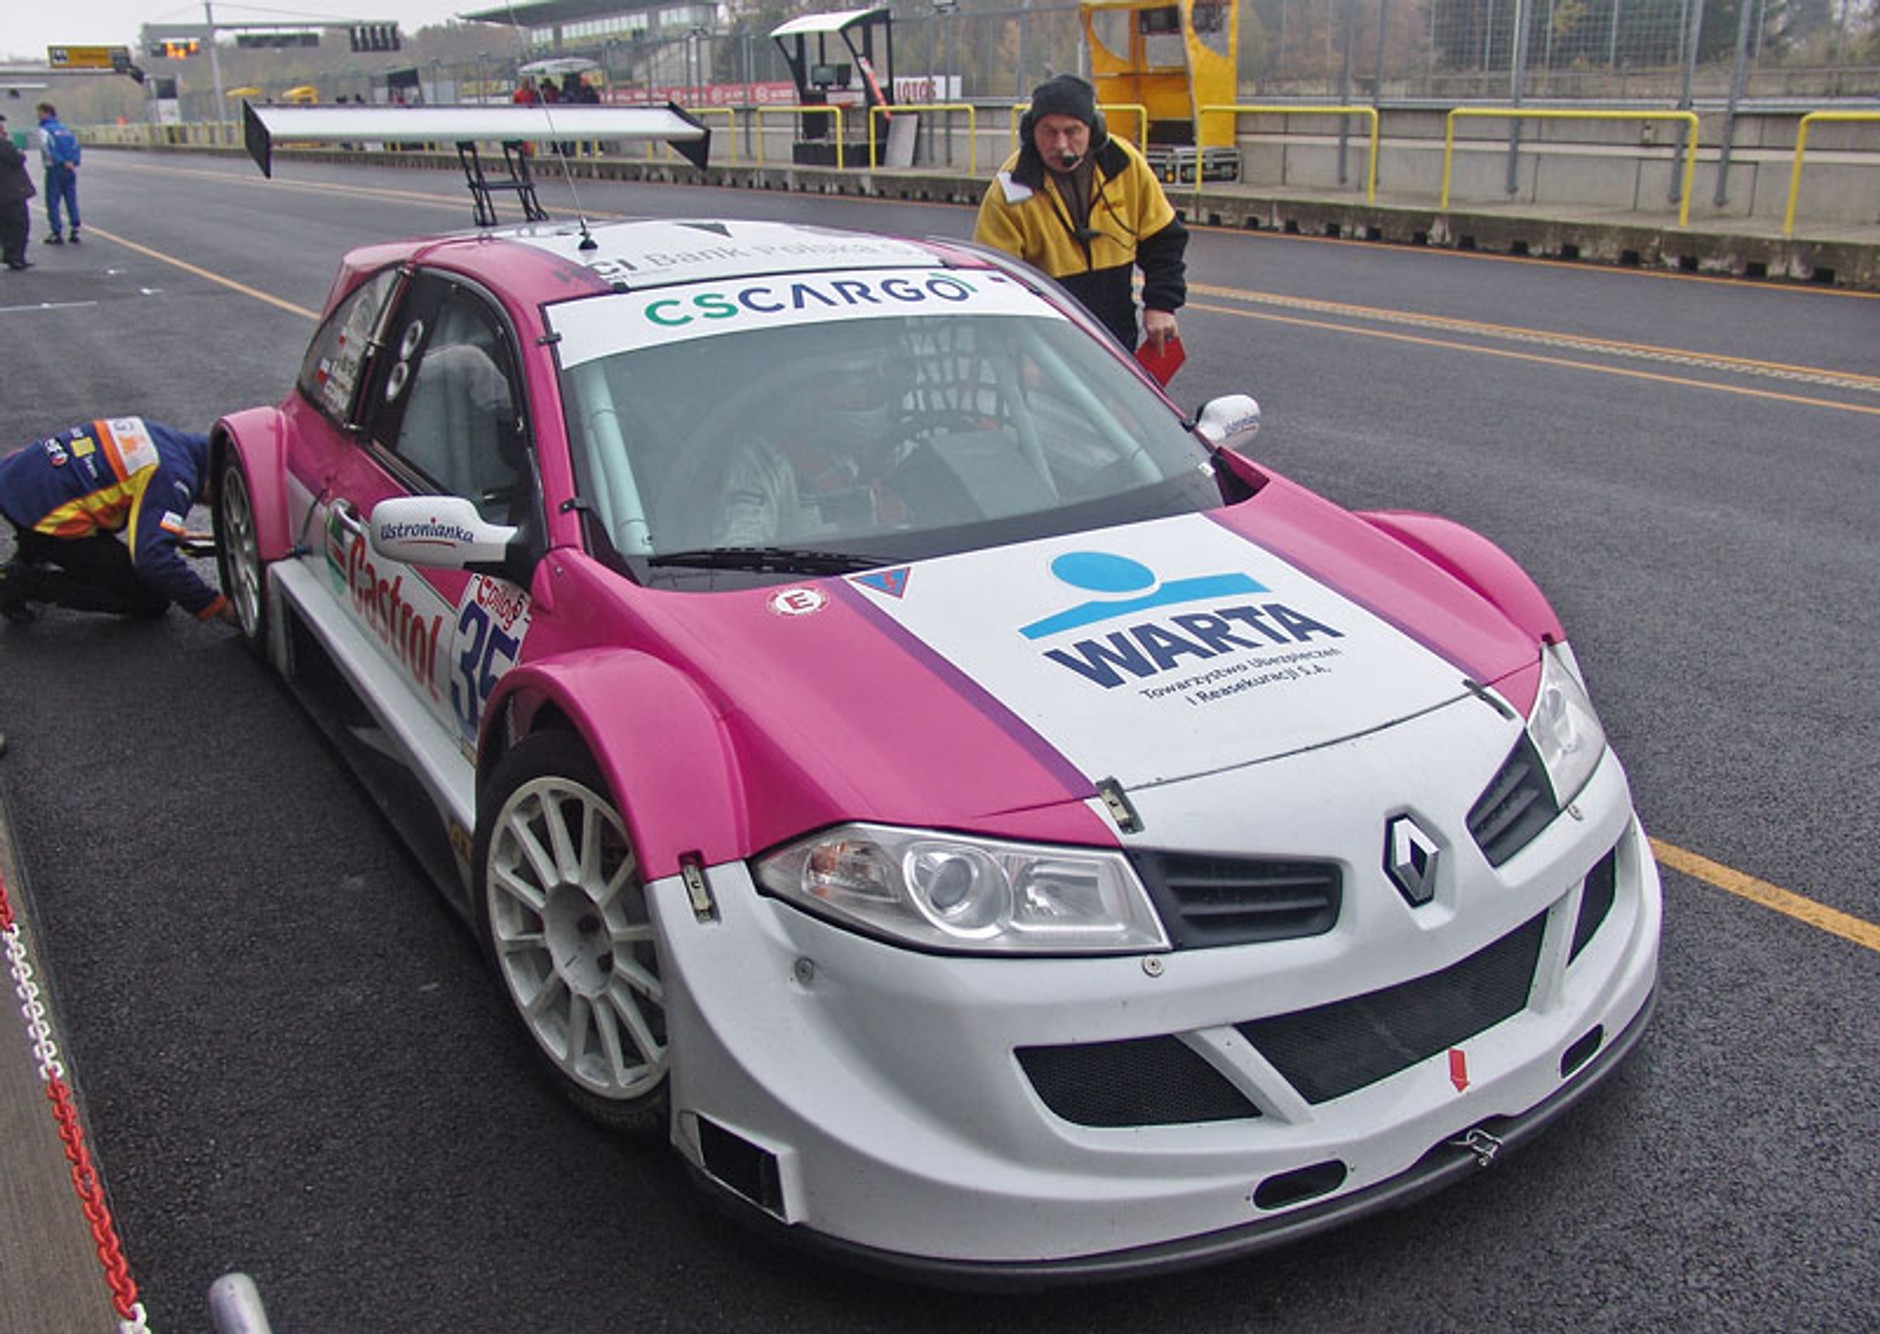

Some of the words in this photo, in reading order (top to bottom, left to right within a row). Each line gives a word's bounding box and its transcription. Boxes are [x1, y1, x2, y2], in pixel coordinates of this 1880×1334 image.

[645, 244, 749, 268] Bank
[350, 533, 443, 701] Castrol
[1043, 603, 1346, 689] WARTA
[1138, 663, 1248, 699] Towarzystwo
